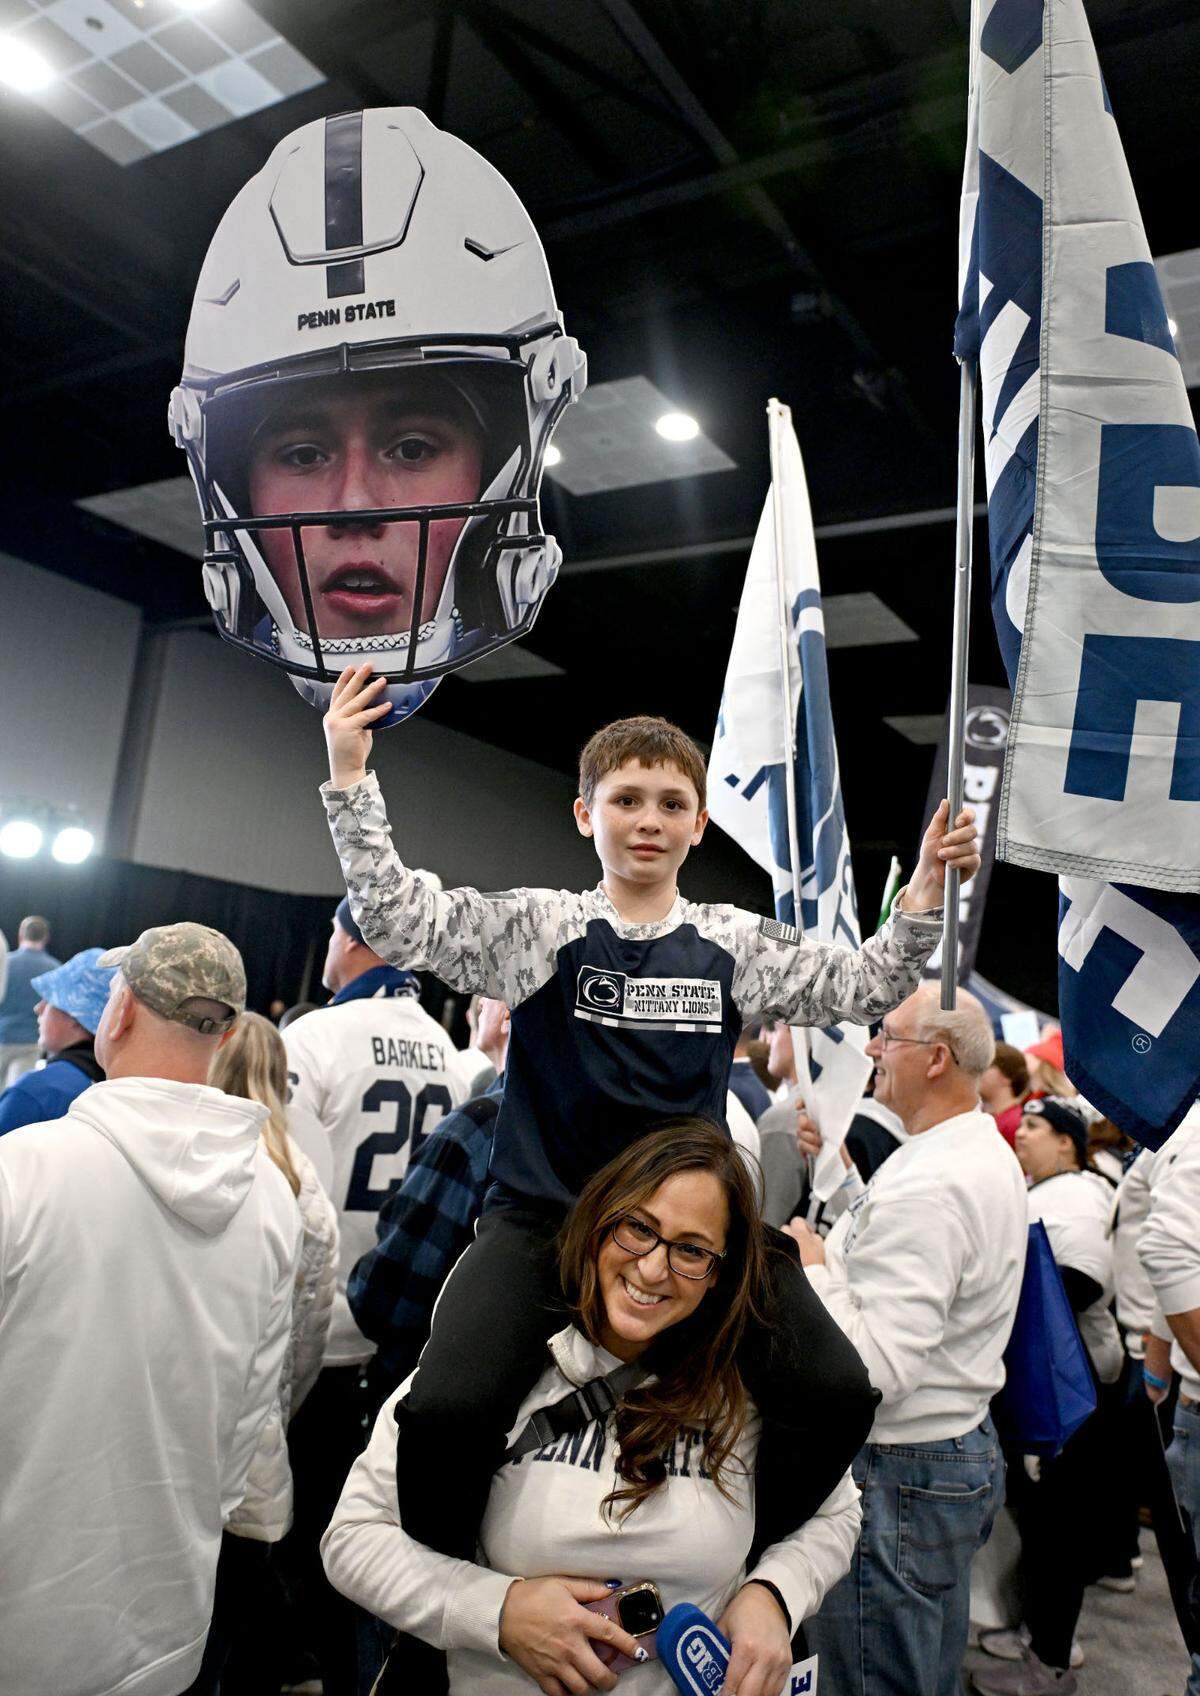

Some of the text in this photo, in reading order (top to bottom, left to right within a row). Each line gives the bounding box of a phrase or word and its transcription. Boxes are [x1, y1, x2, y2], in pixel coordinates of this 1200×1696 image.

[297, 299, 396, 331] PENN STATE
[626, 984, 716, 1000] PENN STATE
[634, 1000, 710, 1015] NITTANY LIONS
[371, 1036, 447, 1073] BARKLEY
